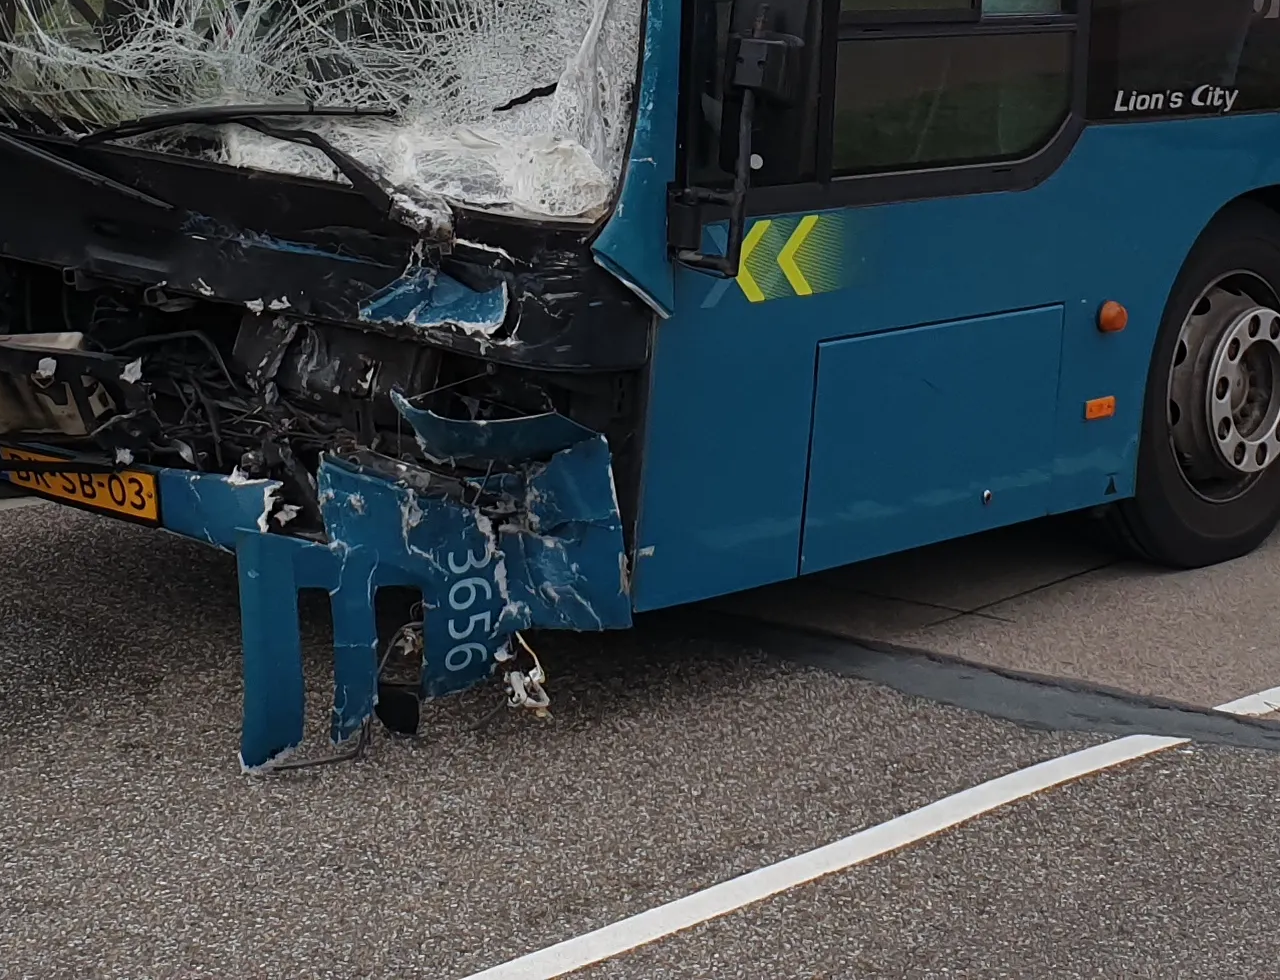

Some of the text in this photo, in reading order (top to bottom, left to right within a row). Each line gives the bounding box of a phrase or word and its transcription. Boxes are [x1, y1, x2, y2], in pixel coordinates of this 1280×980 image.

[1114, 84, 1239, 112] Lion's City
[444, 543, 493, 672] 3656
